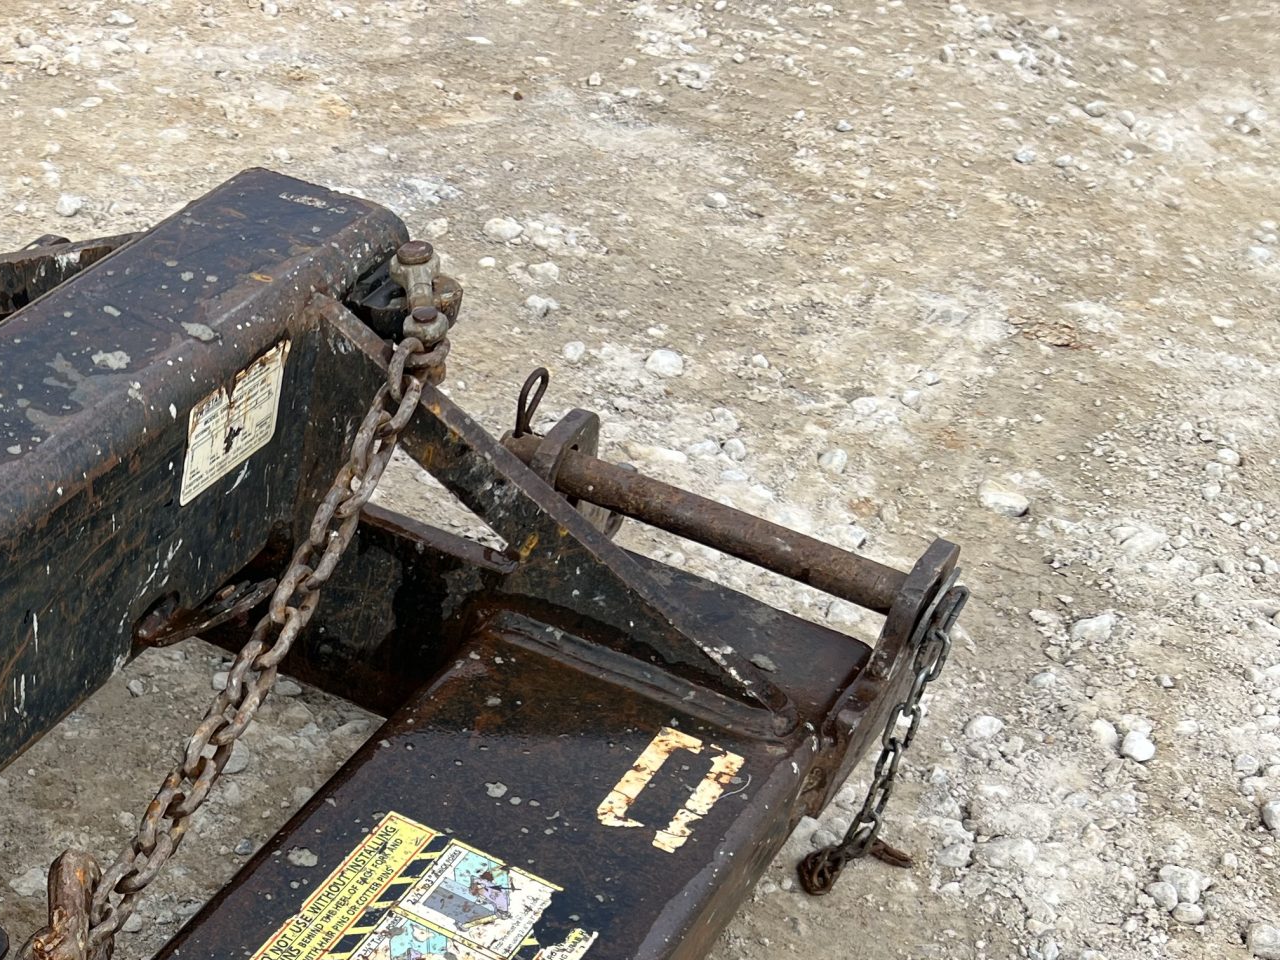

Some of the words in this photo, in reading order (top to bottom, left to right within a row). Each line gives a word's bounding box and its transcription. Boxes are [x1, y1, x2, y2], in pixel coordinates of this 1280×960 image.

[267, 932, 296, 956] NOT
[288, 913, 314, 934] USE
[305, 871, 352, 916] WITHOUT
[344, 823, 398, 874] INSTALLING
[296, 921, 326, 949] BEHIND
[330, 892, 352, 912] HEEL
[345, 883, 361, 895] OF
[354, 866, 377, 886] EACH
[370, 850, 392, 869] FORK
[384, 836, 404, 853] AND
[315, 928, 338, 948] HAIR
[330, 913, 351, 932] PINS
[344, 903, 360, 916] OR
[353, 880, 382, 906] COTTER
[375, 865, 396, 883] PINS
